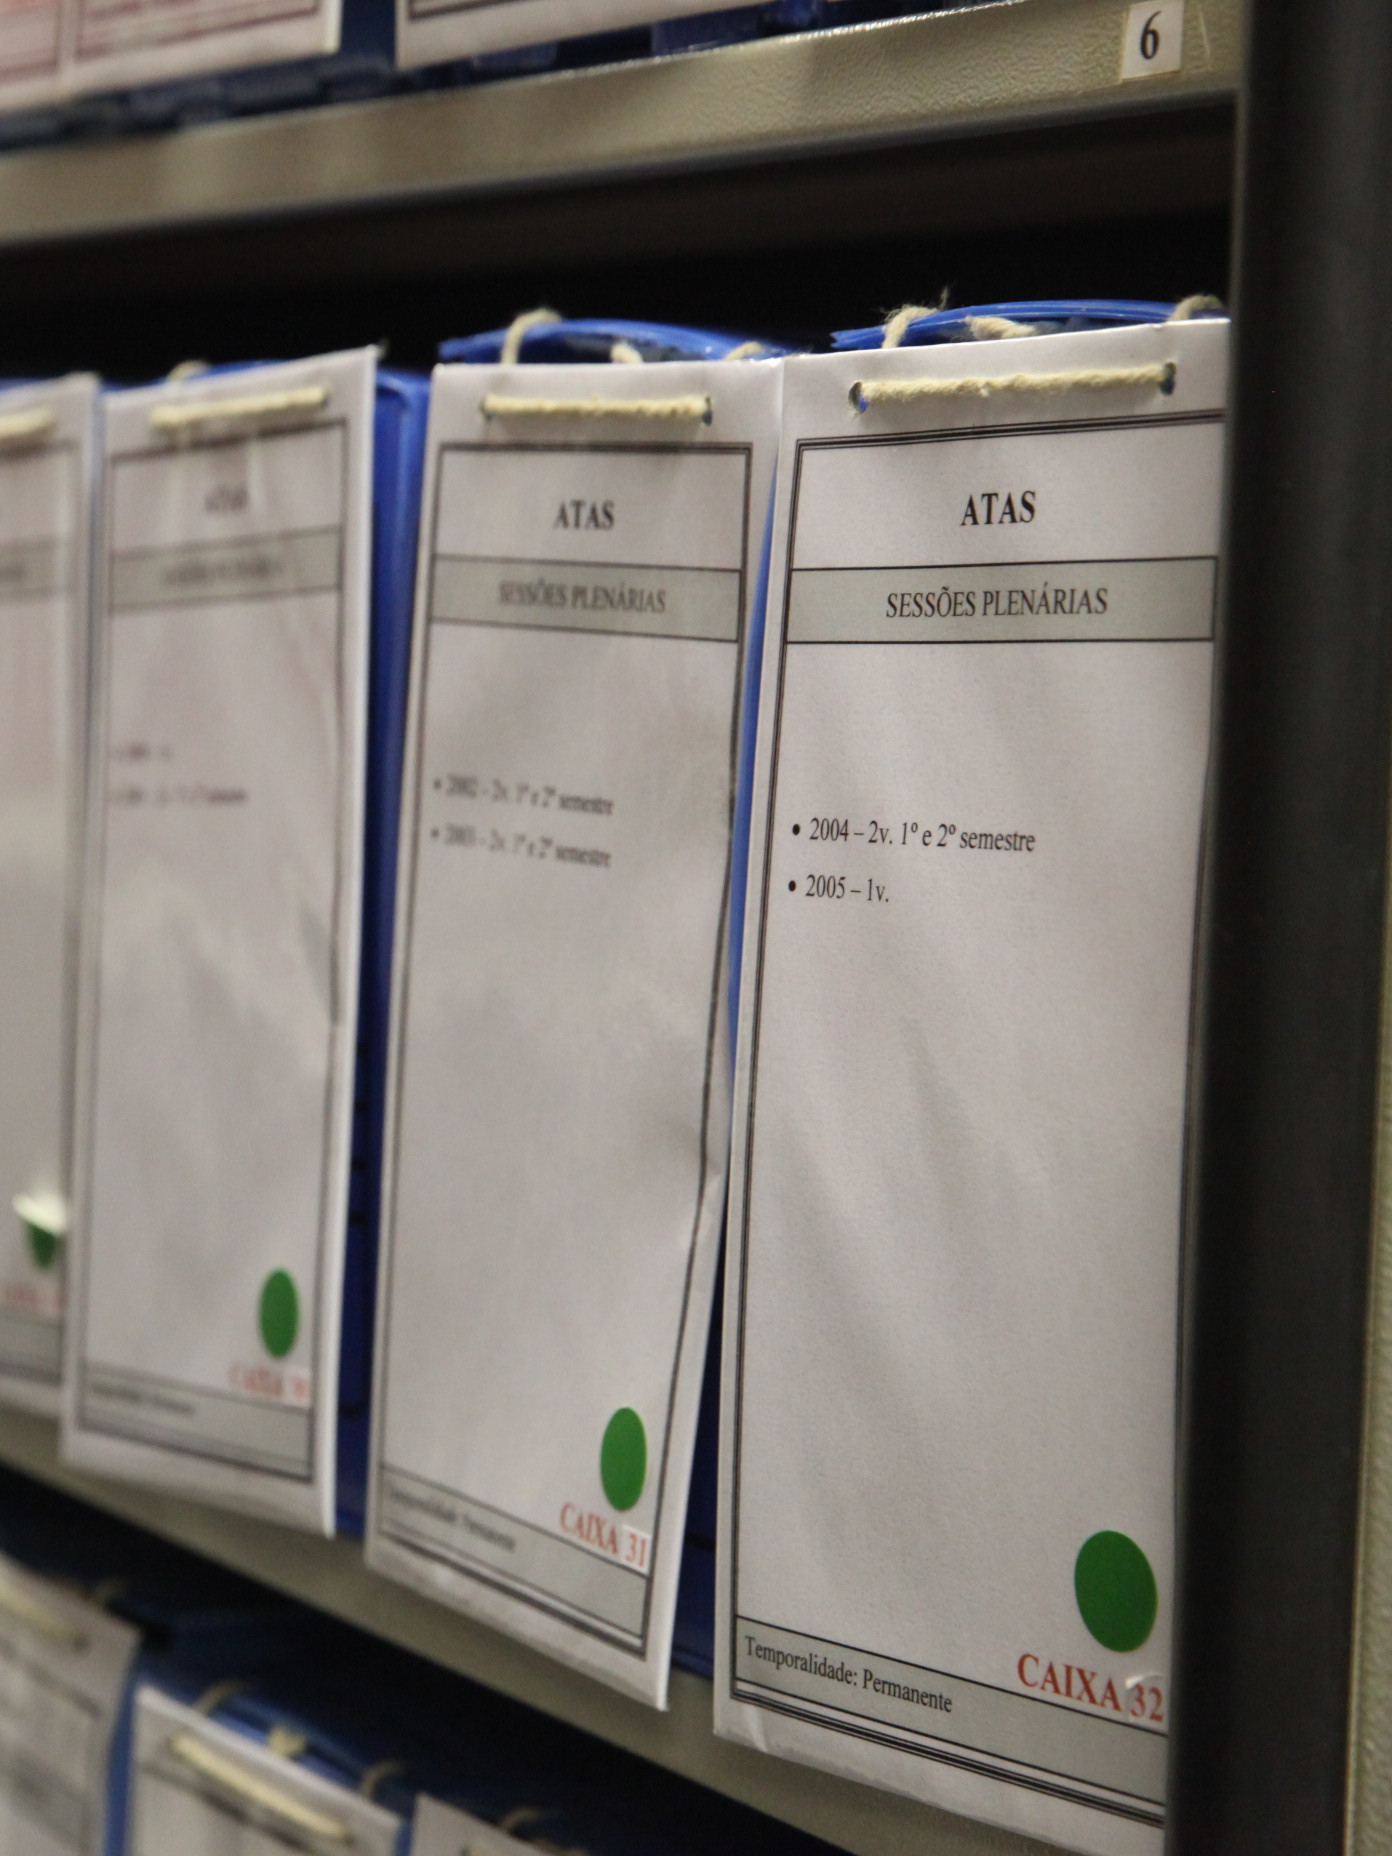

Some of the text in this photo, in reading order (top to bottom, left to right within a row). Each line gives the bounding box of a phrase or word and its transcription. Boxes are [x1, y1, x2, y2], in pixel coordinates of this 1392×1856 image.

[1140, 10, 1162, 60] 6
[554, 499, 615, 530] ATAS
[960, 490, 1036, 526] ATAS
[571, 581, 666, 613] PLENÁRIAS
[886, 581, 1108, 618] SESSÕES PLENÁRIAS
[809, 817, 849, 841] 2004
[868, 820, 893, 844] 2v.
[922, 829, 932, 847] e
[959, 830, 1035, 852] semestre
[805, 874, 846, 899] 2005
[866, 877, 889, 902] 1v.
[560, 1502, 619, 1555] CAIXA
[625, 1532, 647, 1568] 31
[745, 1635, 953, 1713] Temporalidade: Permanente
[1017, 1653, 1164, 1722] CAIXA 32
